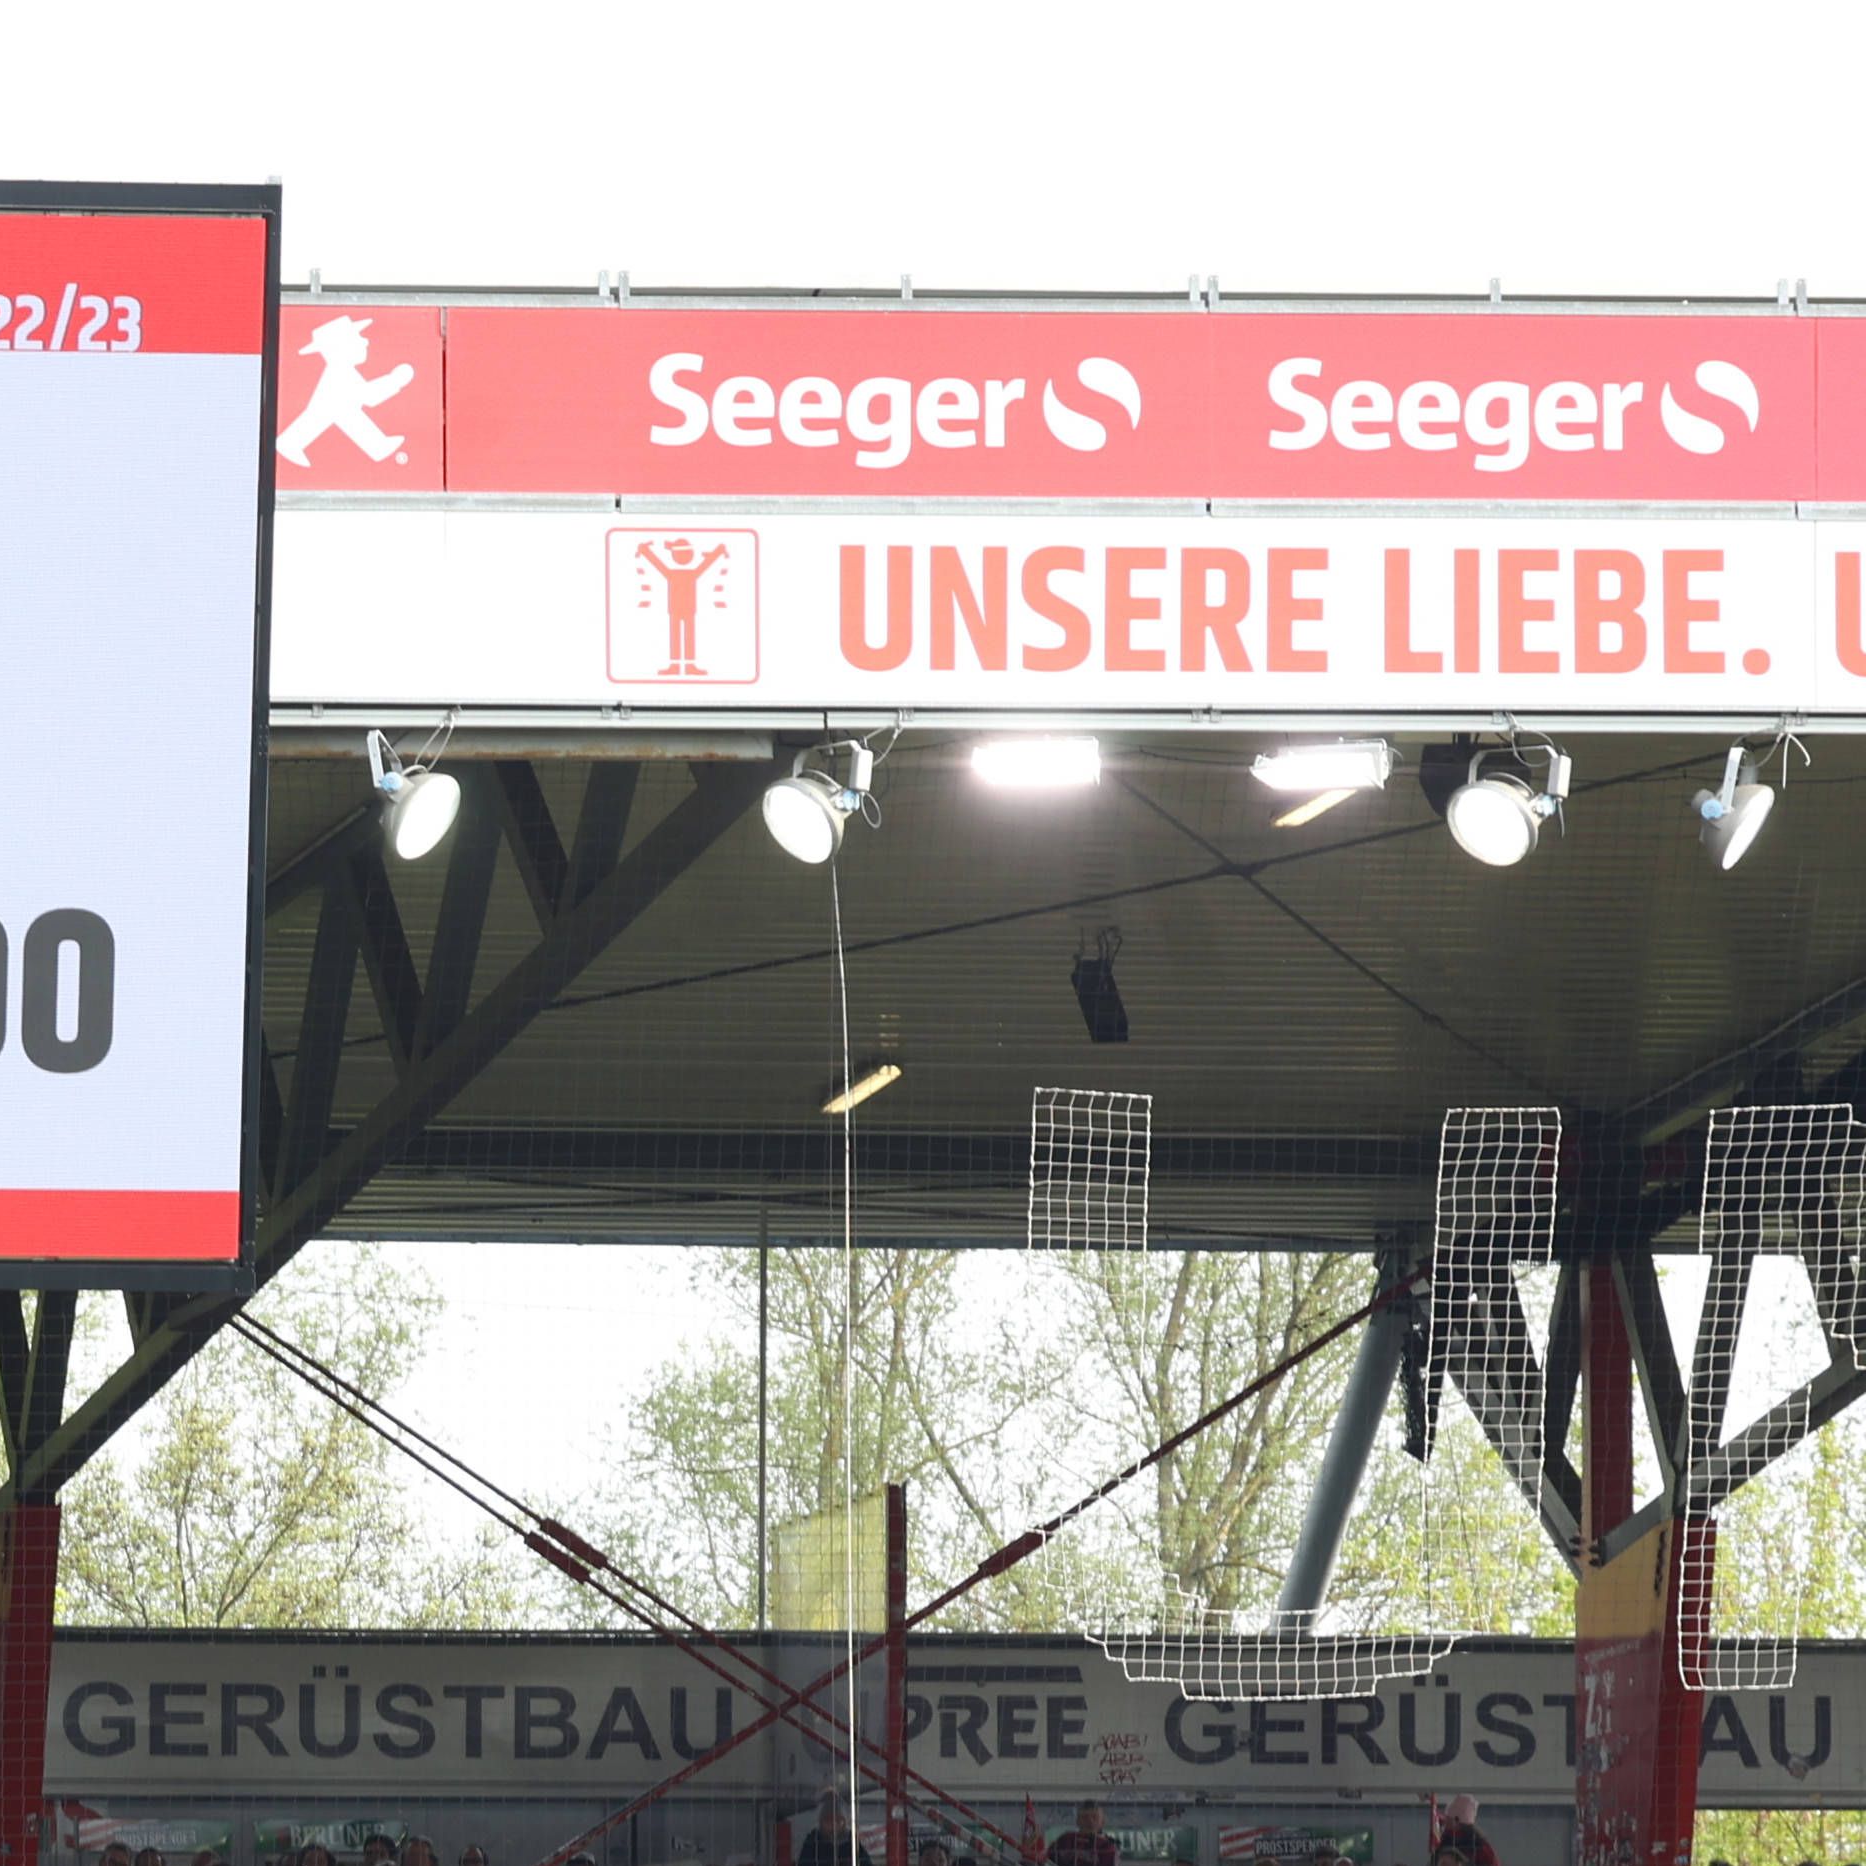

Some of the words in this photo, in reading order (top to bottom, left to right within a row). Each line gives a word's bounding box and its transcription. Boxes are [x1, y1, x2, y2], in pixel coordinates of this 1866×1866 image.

[649, 352, 1025, 469] Seeger
[1268, 356, 1644, 472] Seeger
[838, 545, 1329, 673] UNSERE
[1384, 549, 1771, 676] LIEBE.
[62, 1665, 733, 1761] GERÜSTBAU
[1165, 1674, 1833, 1769] GERÜSAU
[289, 1821, 387, 1845] BERLINER
[1120, 1829, 1178, 1852] LINER
